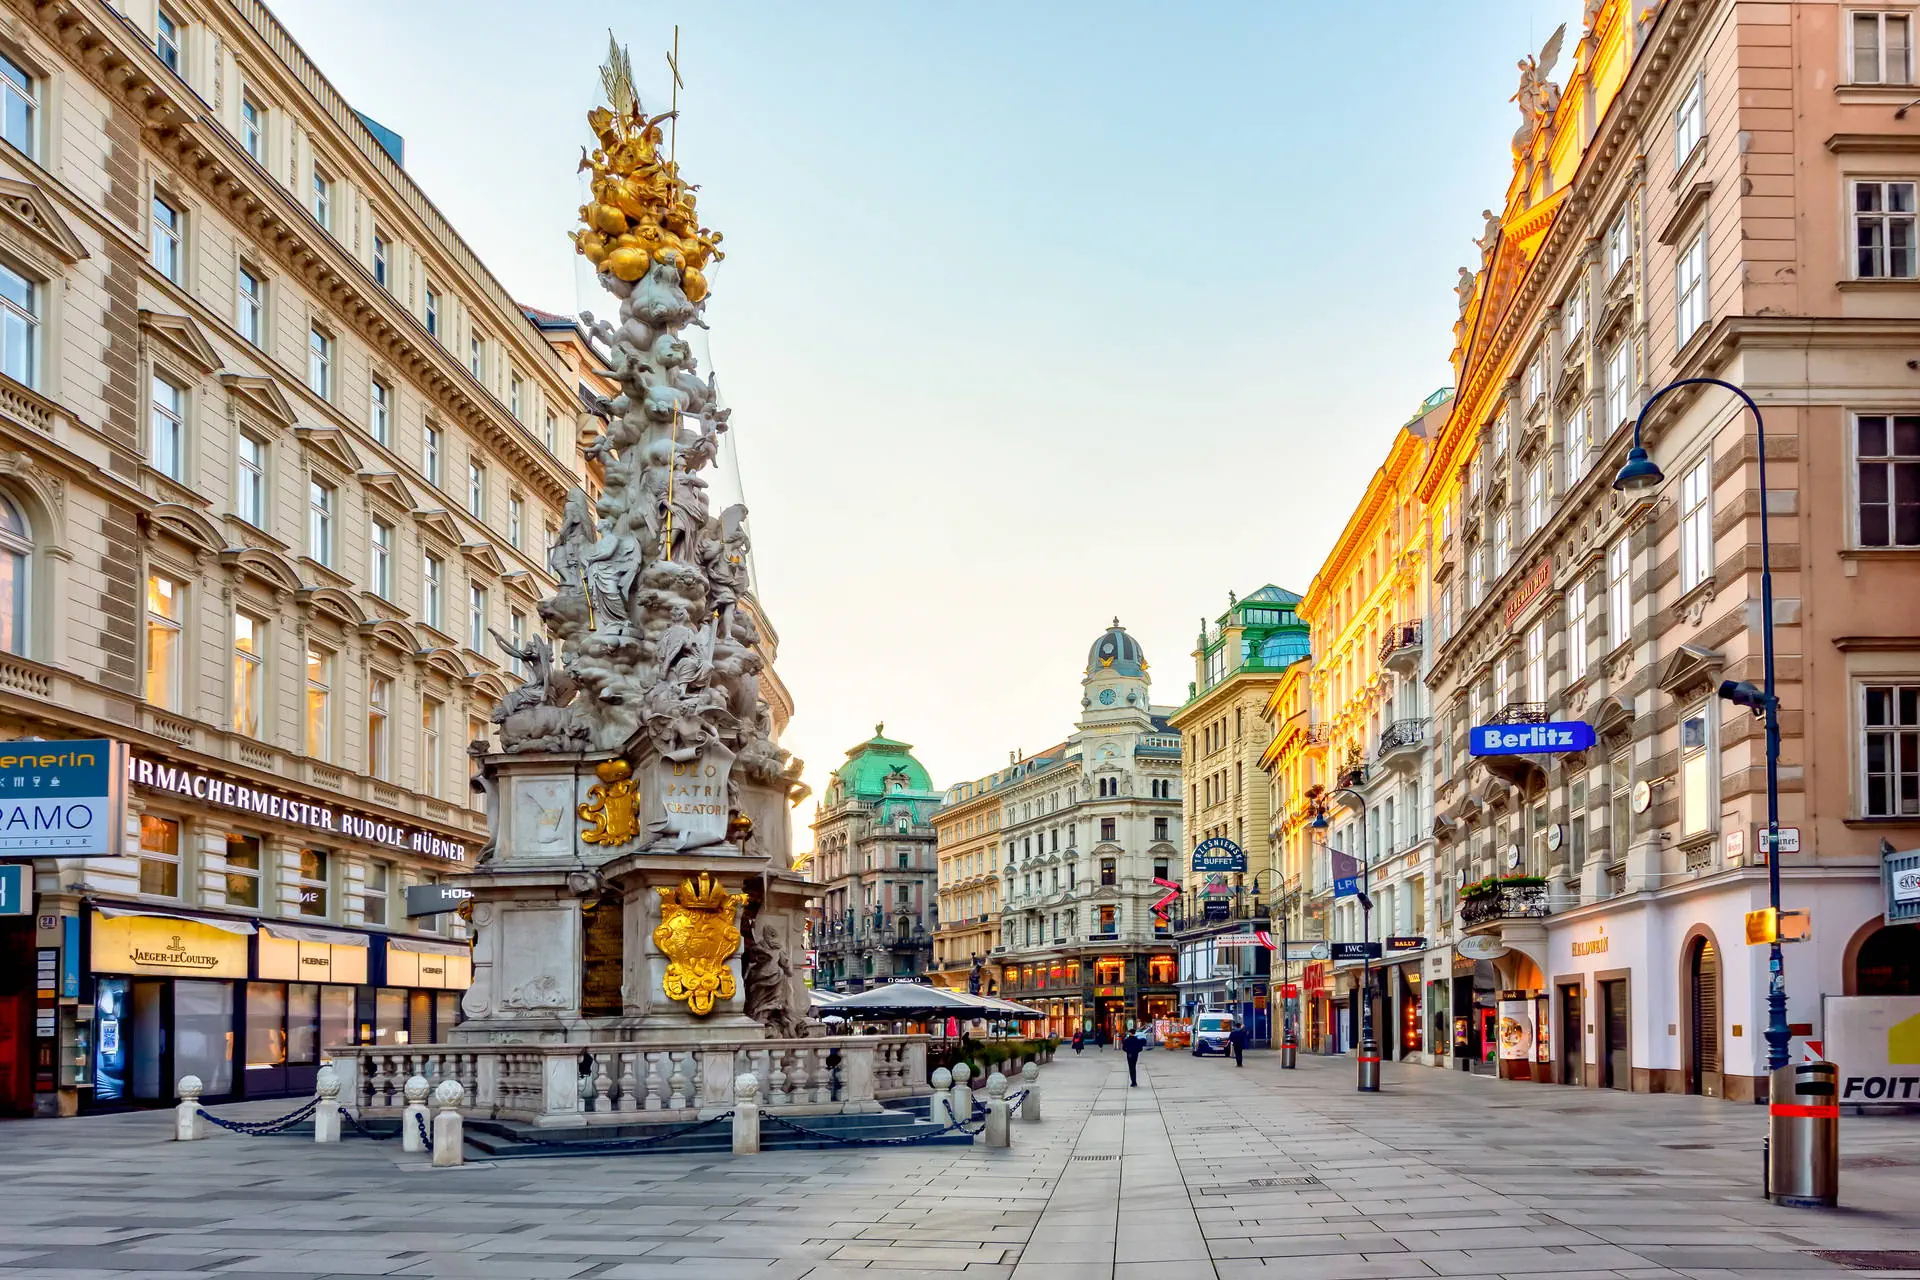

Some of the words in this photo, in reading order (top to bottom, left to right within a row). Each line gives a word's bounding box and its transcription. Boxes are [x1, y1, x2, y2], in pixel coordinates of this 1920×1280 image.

[1484, 727, 1573, 749] Berlitz
[667, 784, 721, 797] PATRI
[342, 814, 404, 846] RUDOLF
[413, 832, 465, 861] HÜBNER
[1345, 945, 1363, 953] IWC
[1843, 1076, 1920, 1099] FOIT
